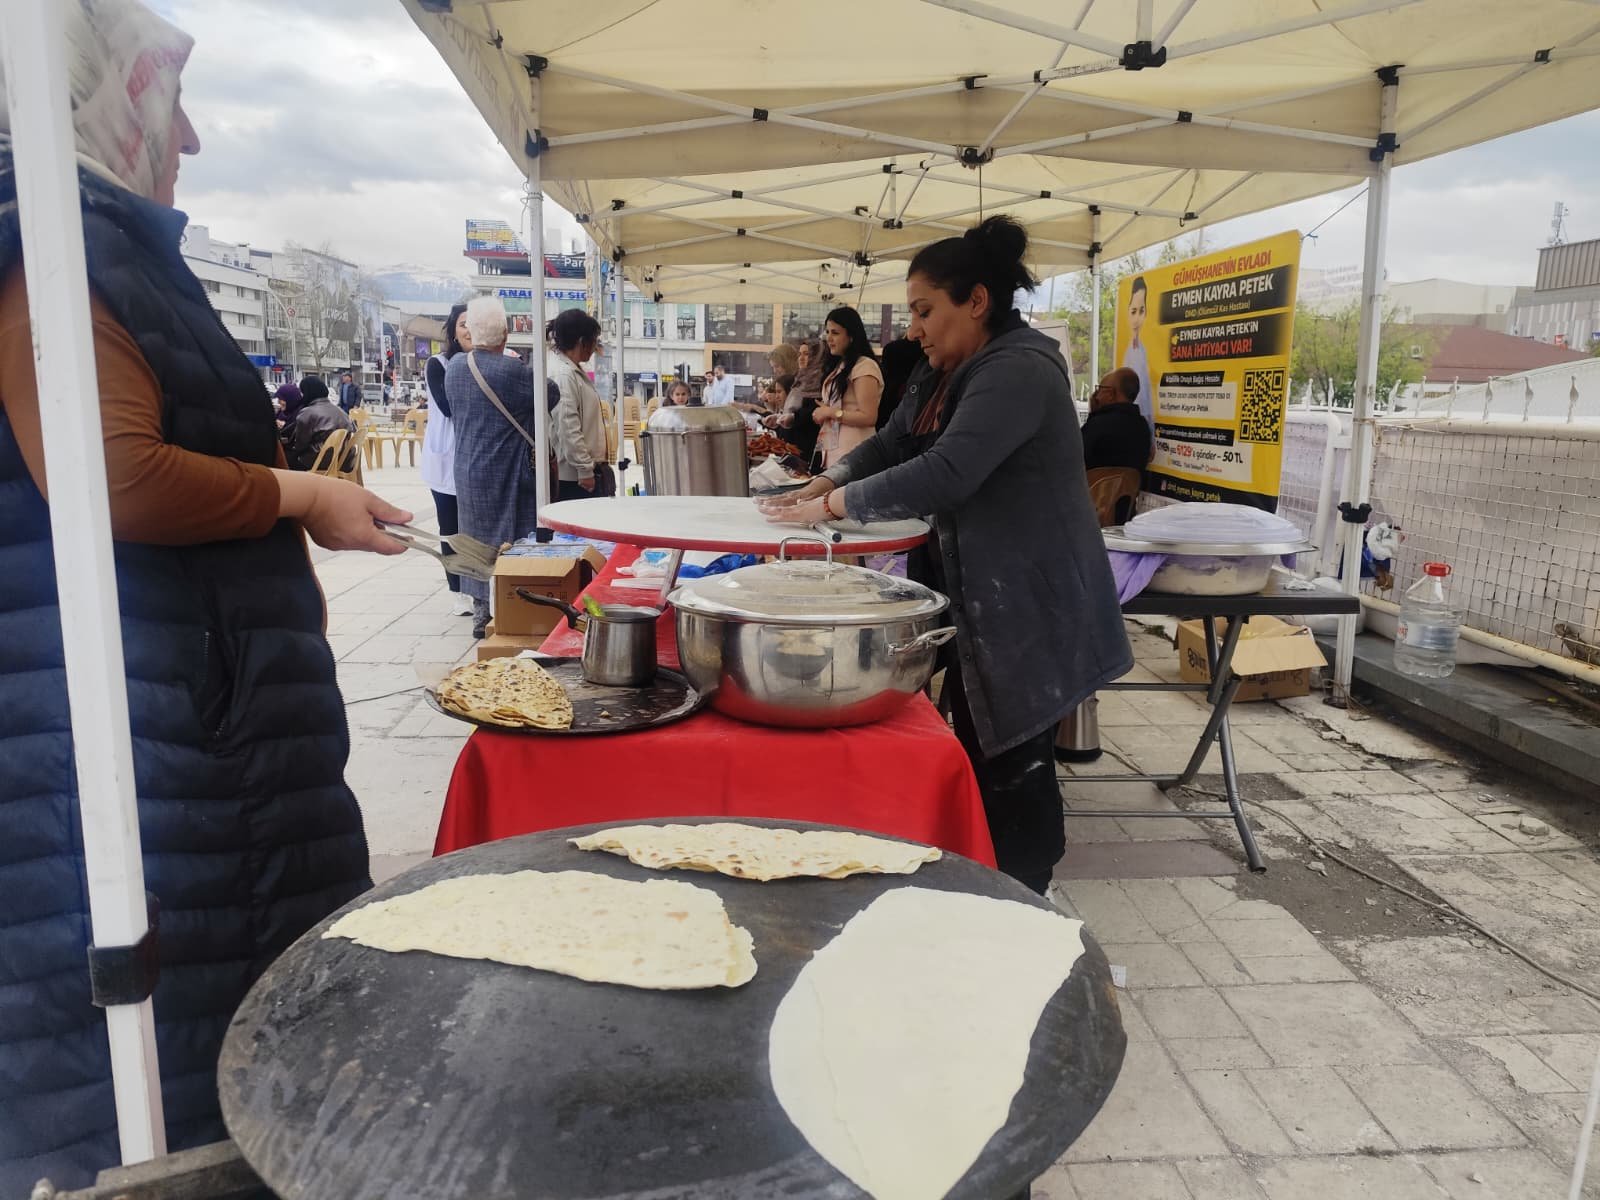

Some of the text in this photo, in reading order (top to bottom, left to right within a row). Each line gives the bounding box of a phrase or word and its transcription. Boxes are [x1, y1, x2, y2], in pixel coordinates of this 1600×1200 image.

[564, 256, 586, 268] Par
[1238, 250, 1272, 272] EVLADI
[1172, 273, 1274, 308] EYMEN KAYRA PETEK
[1179, 320, 1259, 342] EYMEN KAYRA PETEK'İN
[1171, 338, 1252, 359] SANA İHTİYACI VAR!
[1196, 449, 1216, 460] gönder
[1222, 452, 1233, 462] 50
[1234, 453, 1243, 463] TL
